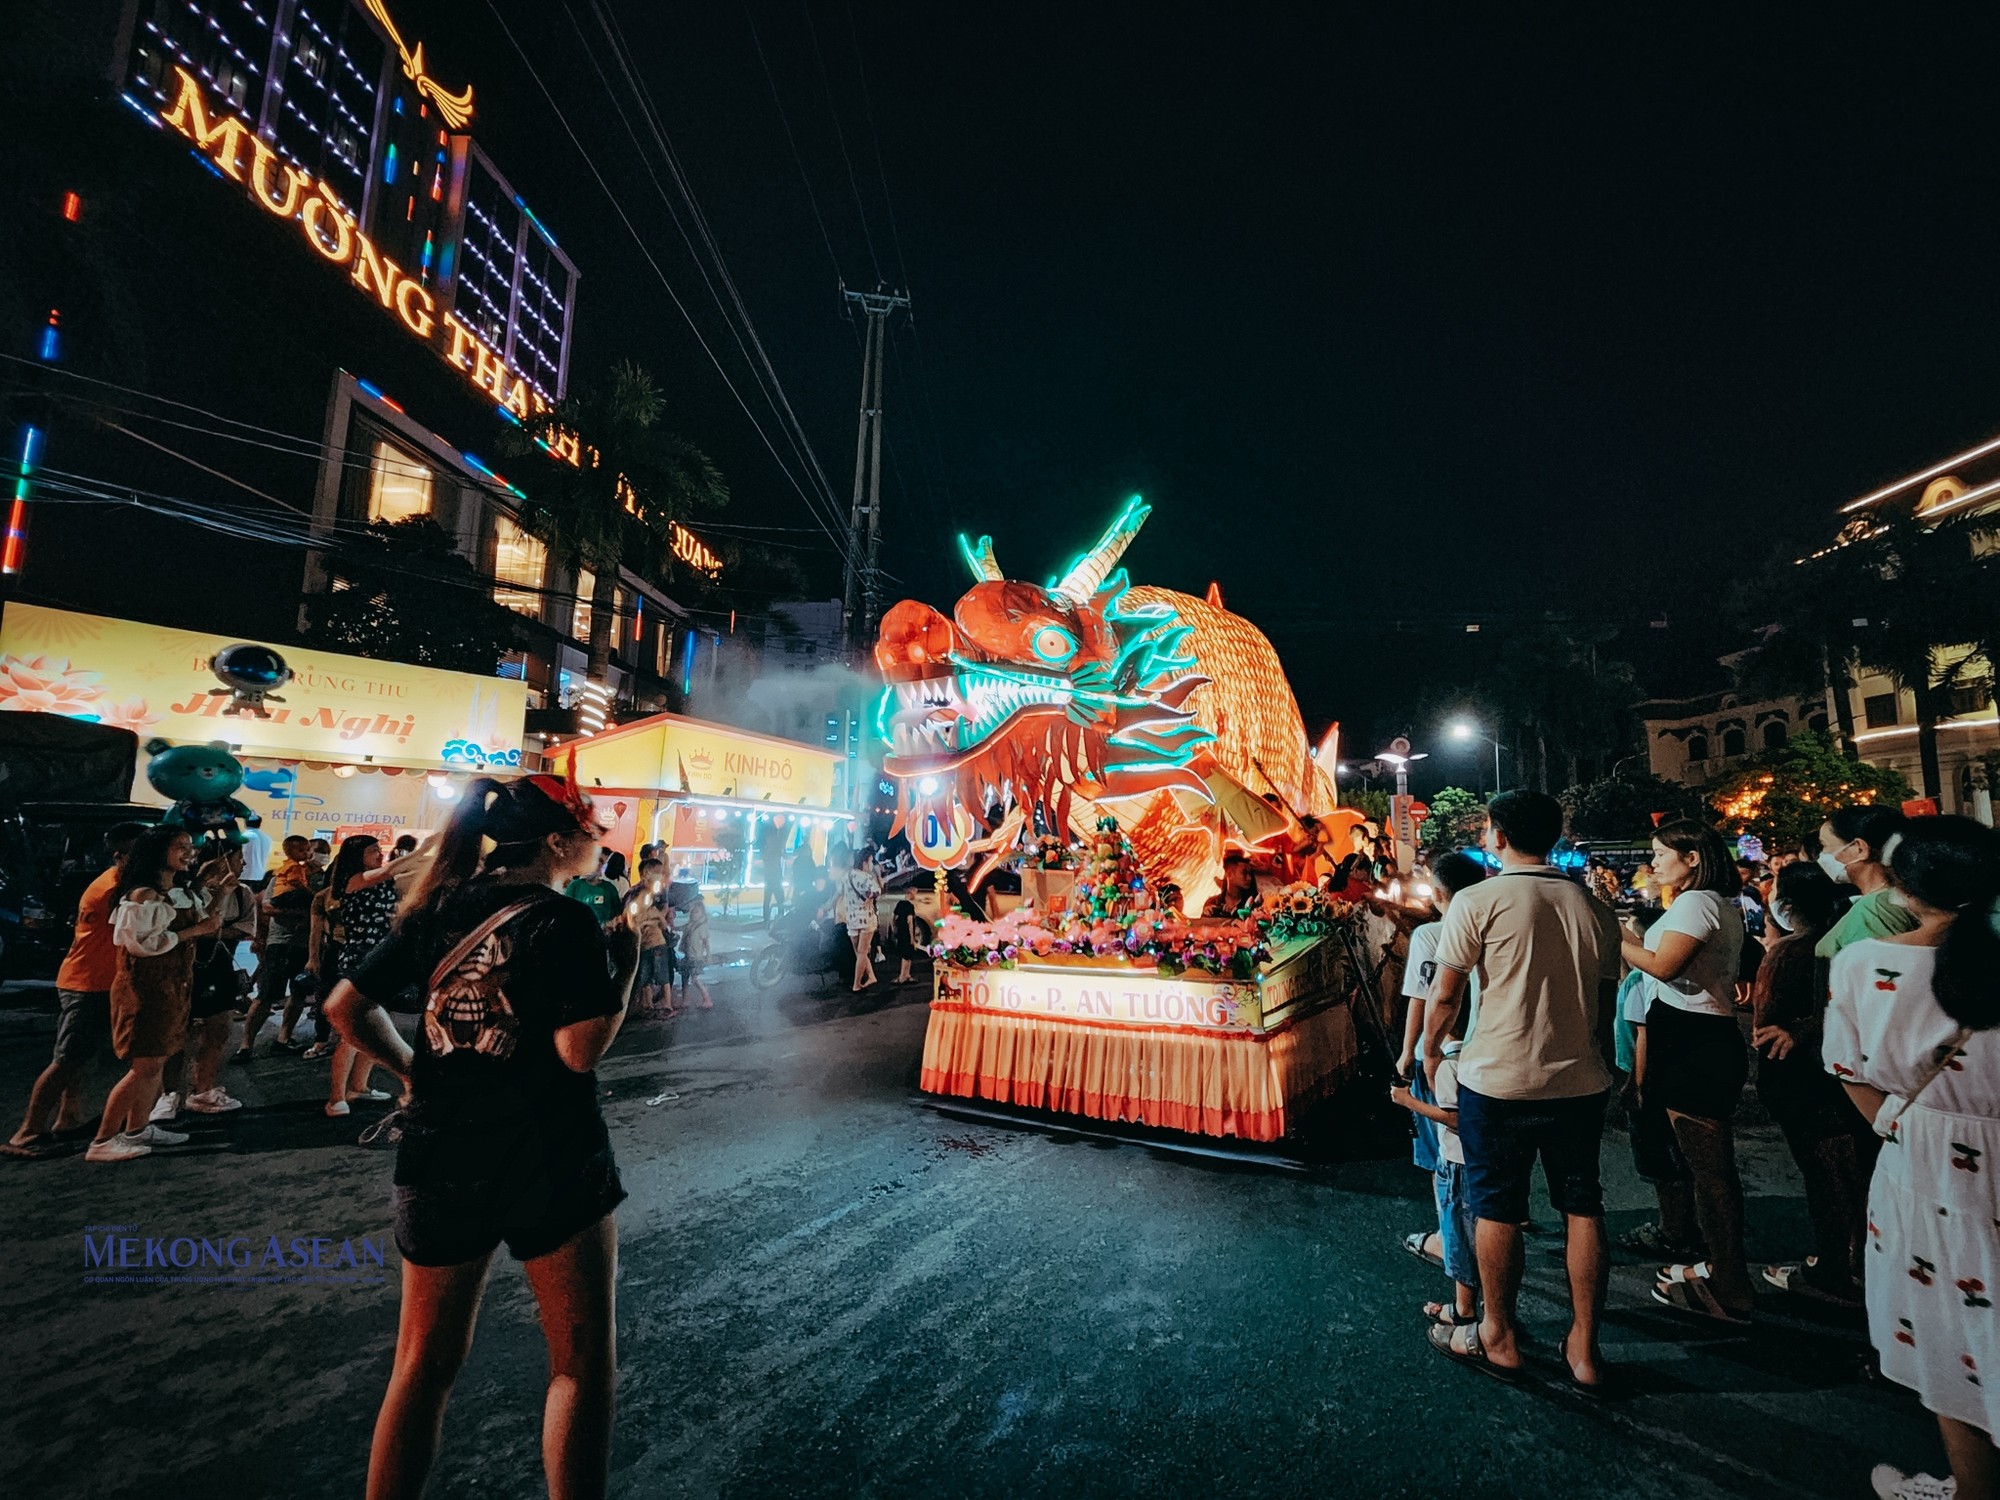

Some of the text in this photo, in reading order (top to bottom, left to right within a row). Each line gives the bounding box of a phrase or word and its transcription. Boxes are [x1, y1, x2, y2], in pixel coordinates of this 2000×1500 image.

[161, 65, 434, 339] MƯỜNG
[291, 671, 409, 698] RUNG THU
[169, 691, 415, 744] Hu Nghị
[724, 752, 793, 781] KINH ĐÔ
[304, 811, 341, 823] GIAO
[344, 811, 380, 824] THỜI
[382, 815, 406, 827] ĐẠI
[957, 971, 991, 1006] TỔ
[999, 984, 1022, 1009] 16
[1046, 987, 1067, 1012] P.
[1076, 989, 1113, 1017] AN
[1122, 985, 1229, 1026] TƯỜNG
